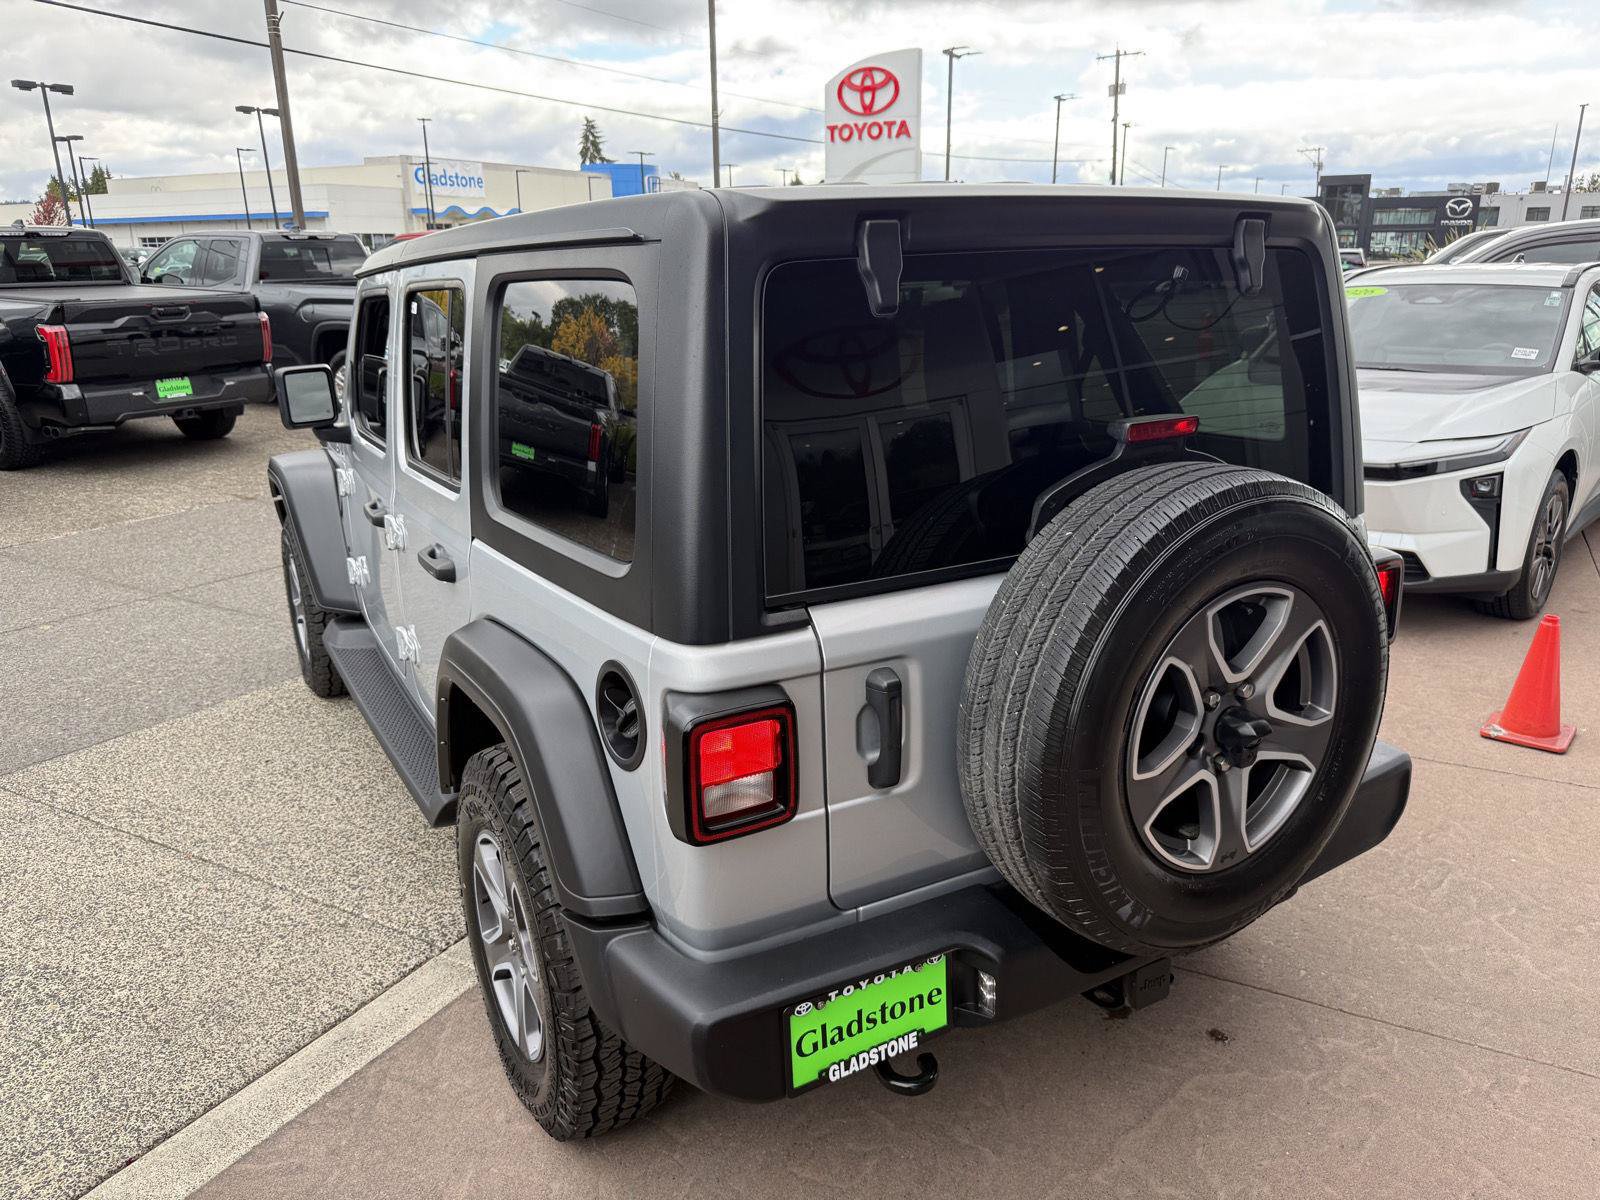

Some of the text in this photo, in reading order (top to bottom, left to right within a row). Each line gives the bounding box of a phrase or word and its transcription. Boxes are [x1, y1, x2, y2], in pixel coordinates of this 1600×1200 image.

[826, 119, 912, 144] TOYOTA
[828, 964, 914, 1002] TOYOTA
[795, 987, 943, 1058] Gladstone
[828, 1031, 918, 1082] GLADSTONE
